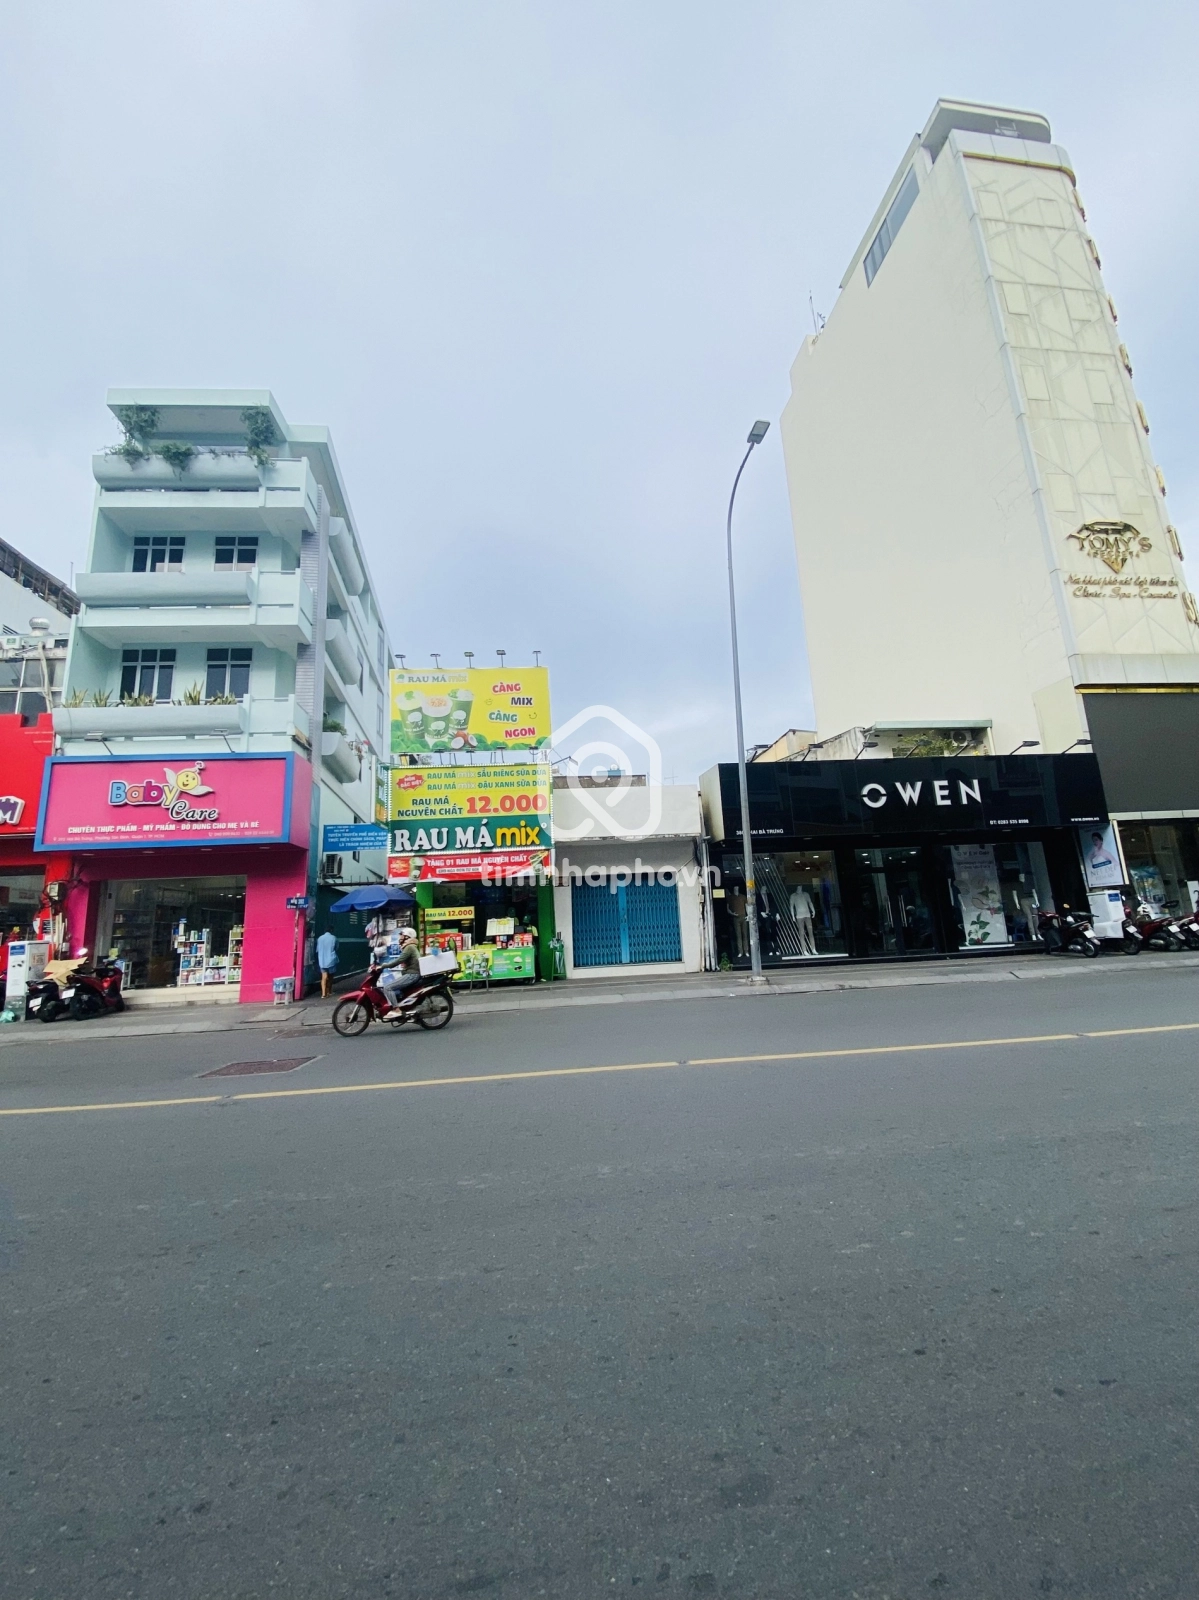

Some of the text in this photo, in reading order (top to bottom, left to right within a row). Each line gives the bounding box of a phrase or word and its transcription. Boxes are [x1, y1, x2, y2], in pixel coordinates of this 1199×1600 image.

[432, 674, 446, 682] MÁ
[492, 682, 521, 693] CÀNG
[511, 697, 533, 706] MIX
[489, 710, 517, 722] CÀNG
[505, 727, 535, 738] NGON
[478, 781, 493, 790] ĐẬU
[109, 780, 177, 808] Baby
[861, 778, 982, 809] OWEN
[398, 794, 548, 817] NGUYÊN CHẤT 12.000
[412, 796, 449, 806] RAU MÁ
[169, 800, 219, 821] Care
[68, 825, 95, 834] CHUYÊN
[97, 825, 114, 834] THỰC
[116, 822, 137, 832] PHẨM
[143, 823, 154, 831] MỸ
[156, 822, 175, 830] PHẨM
[192, 822, 211, 830] DÙNG
[394, 818, 540, 852] RAU MÁ mix
[510, 854, 527, 862] CHẤT
